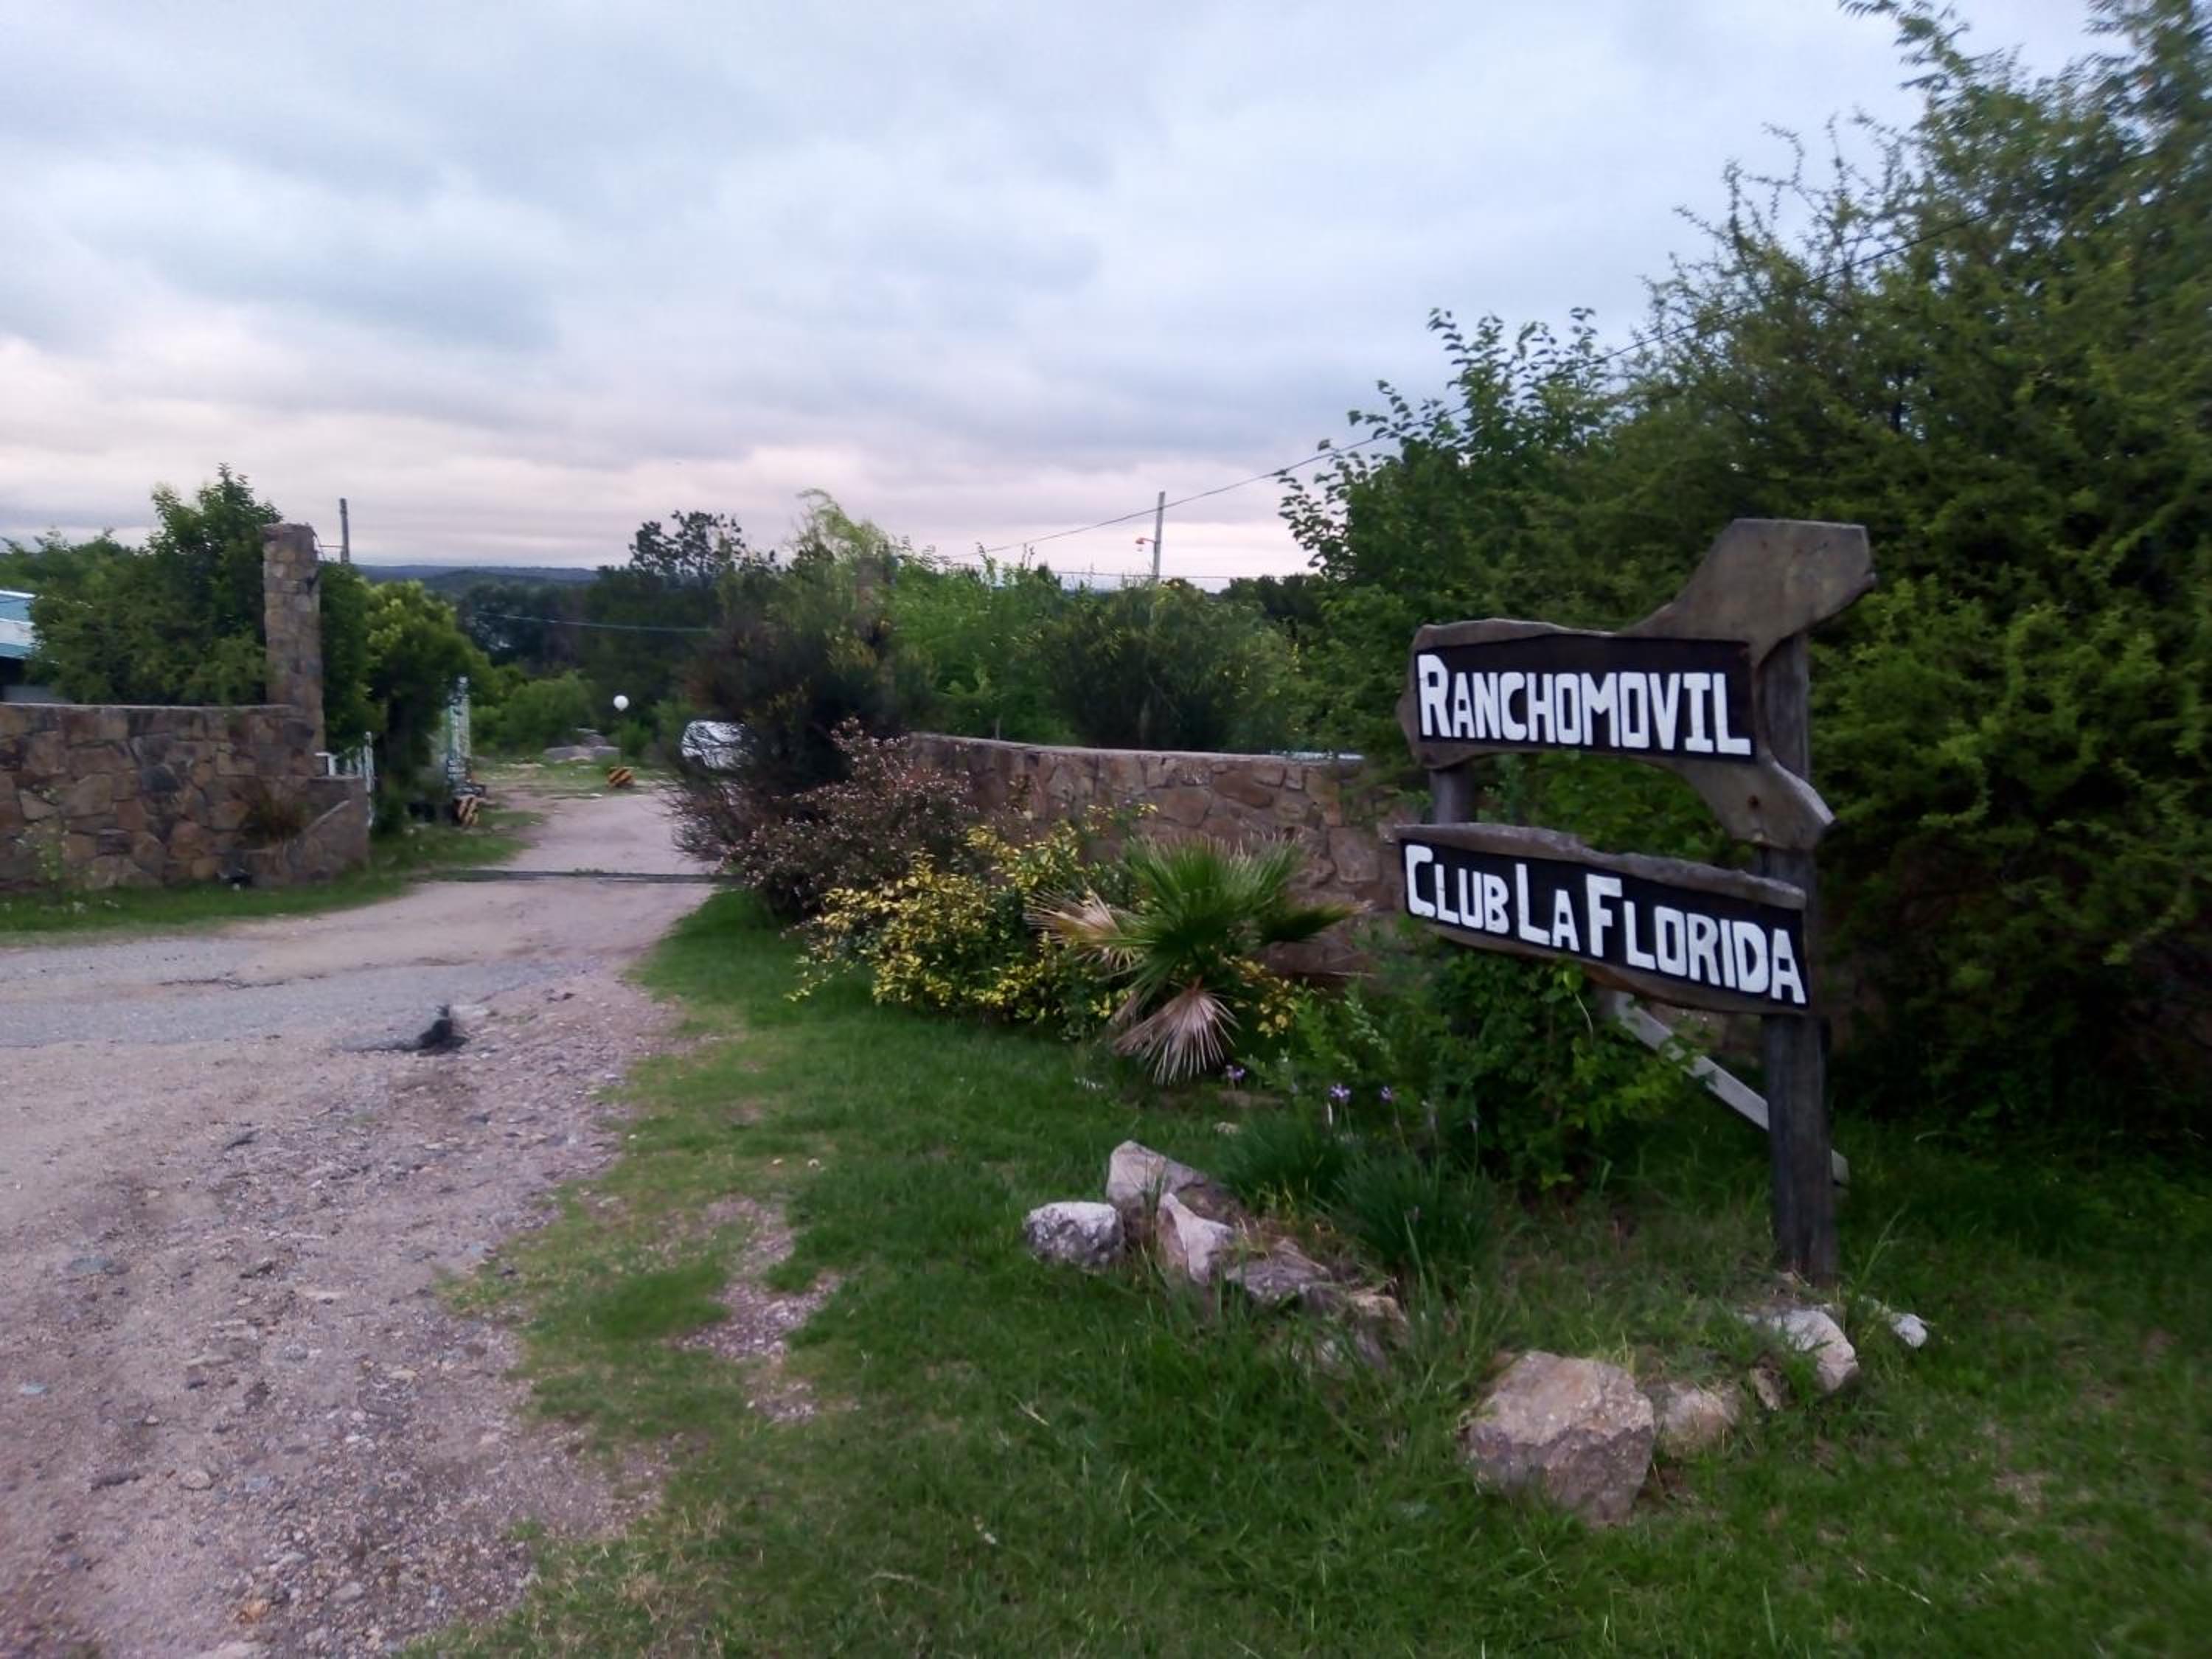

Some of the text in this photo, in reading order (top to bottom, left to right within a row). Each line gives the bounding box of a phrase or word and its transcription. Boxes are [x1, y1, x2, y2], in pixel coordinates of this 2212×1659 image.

[1417, 654, 1750, 755] RANCHOMOVIL
[1405, 844, 1806, 1004] CLUB LA FLORIDA
